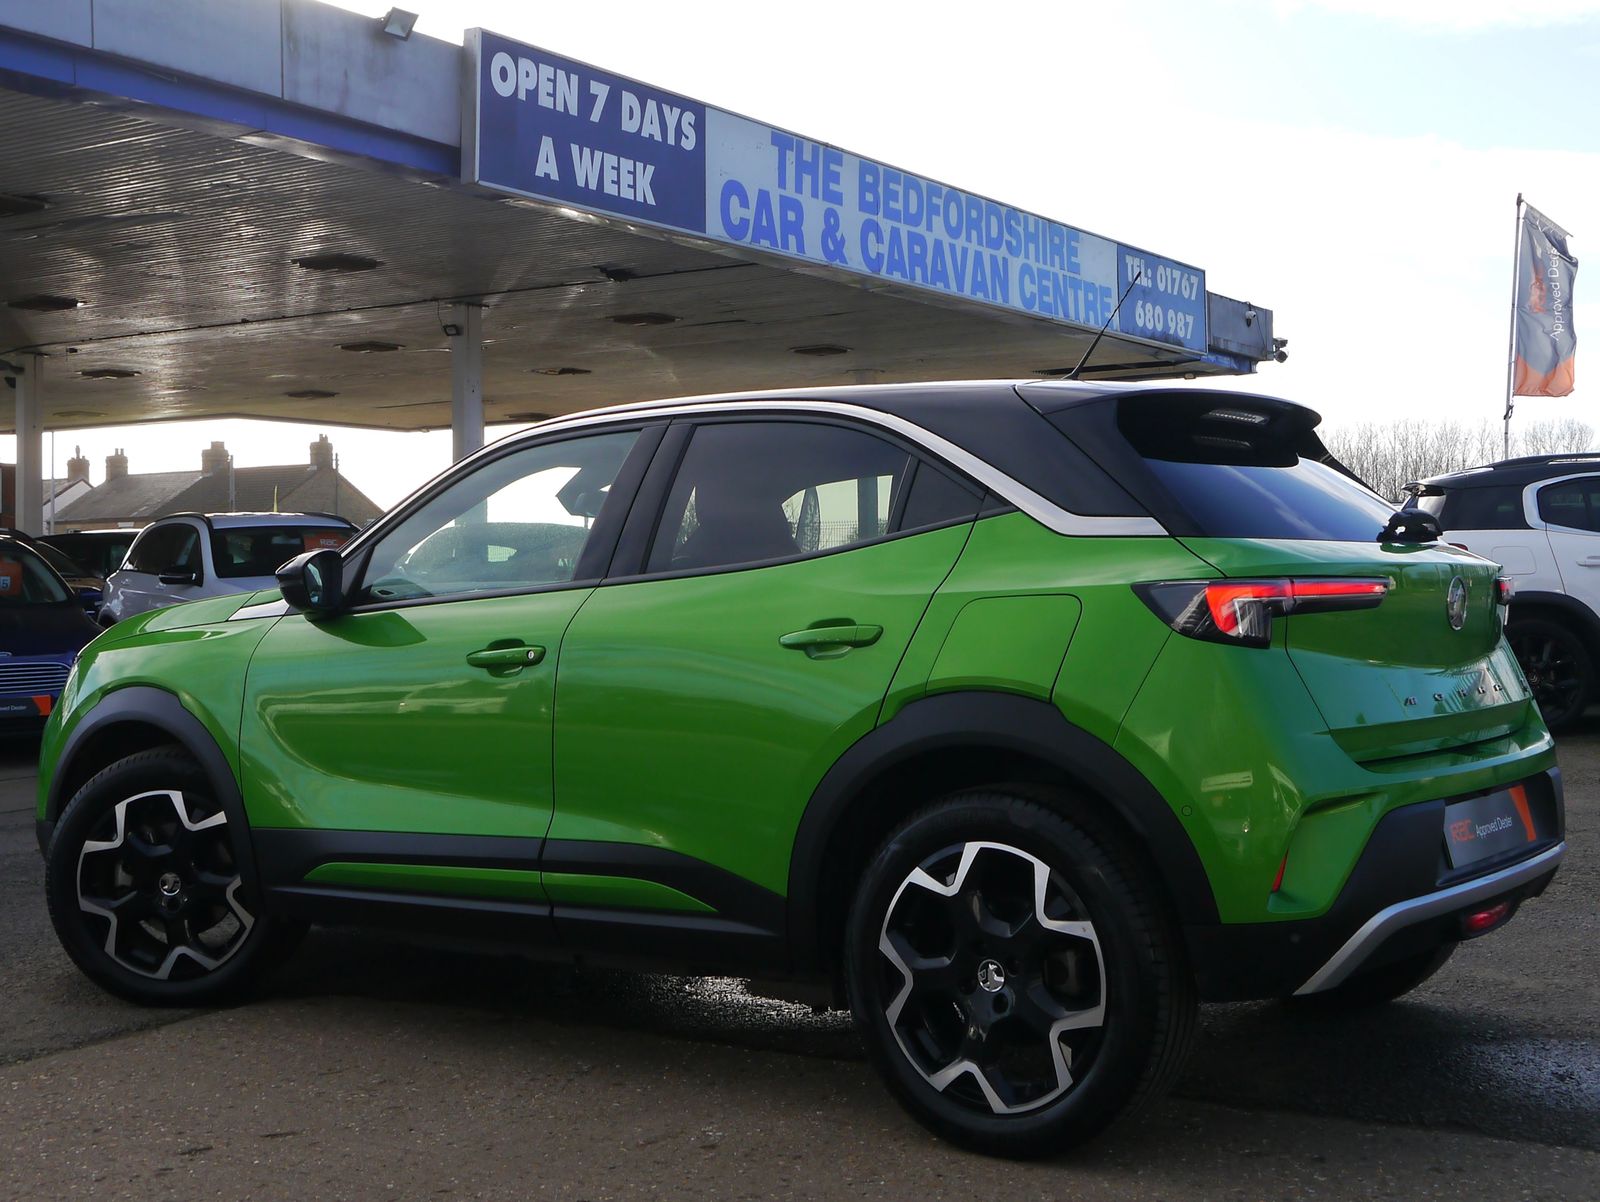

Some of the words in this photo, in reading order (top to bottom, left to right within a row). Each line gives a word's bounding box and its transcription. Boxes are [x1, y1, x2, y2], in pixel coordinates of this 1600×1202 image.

[490, 51, 579, 117] OPEN
[589, 80, 611, 123] 7
[621, 90, 697, 151] DAYS
[535, 136, 560, 182] A
[570, 143, 657, 206] WEEK
[771, 131, 843, 207] THE
[858, 160, 1081, 275] BEDFORDSHIRE
[720, 179, 806, 255] CAR
[821, 207, 849, 265] &
[860, 219, 1010, 304] CARAVAN
[1018, 264, 1116, 331] CENTRE
[1125, 255, 1153, 288] TEL:
[1157, 265, 1199, 300] 01767
[1135, 300, 1164, 331] 680
[1168, 309, 1194, 339] 987
[1550, 281, 1565, 341] Approved
[1475, 817, 1499, 839] Approved
[1498, 815, 1513, 830] Dealer
